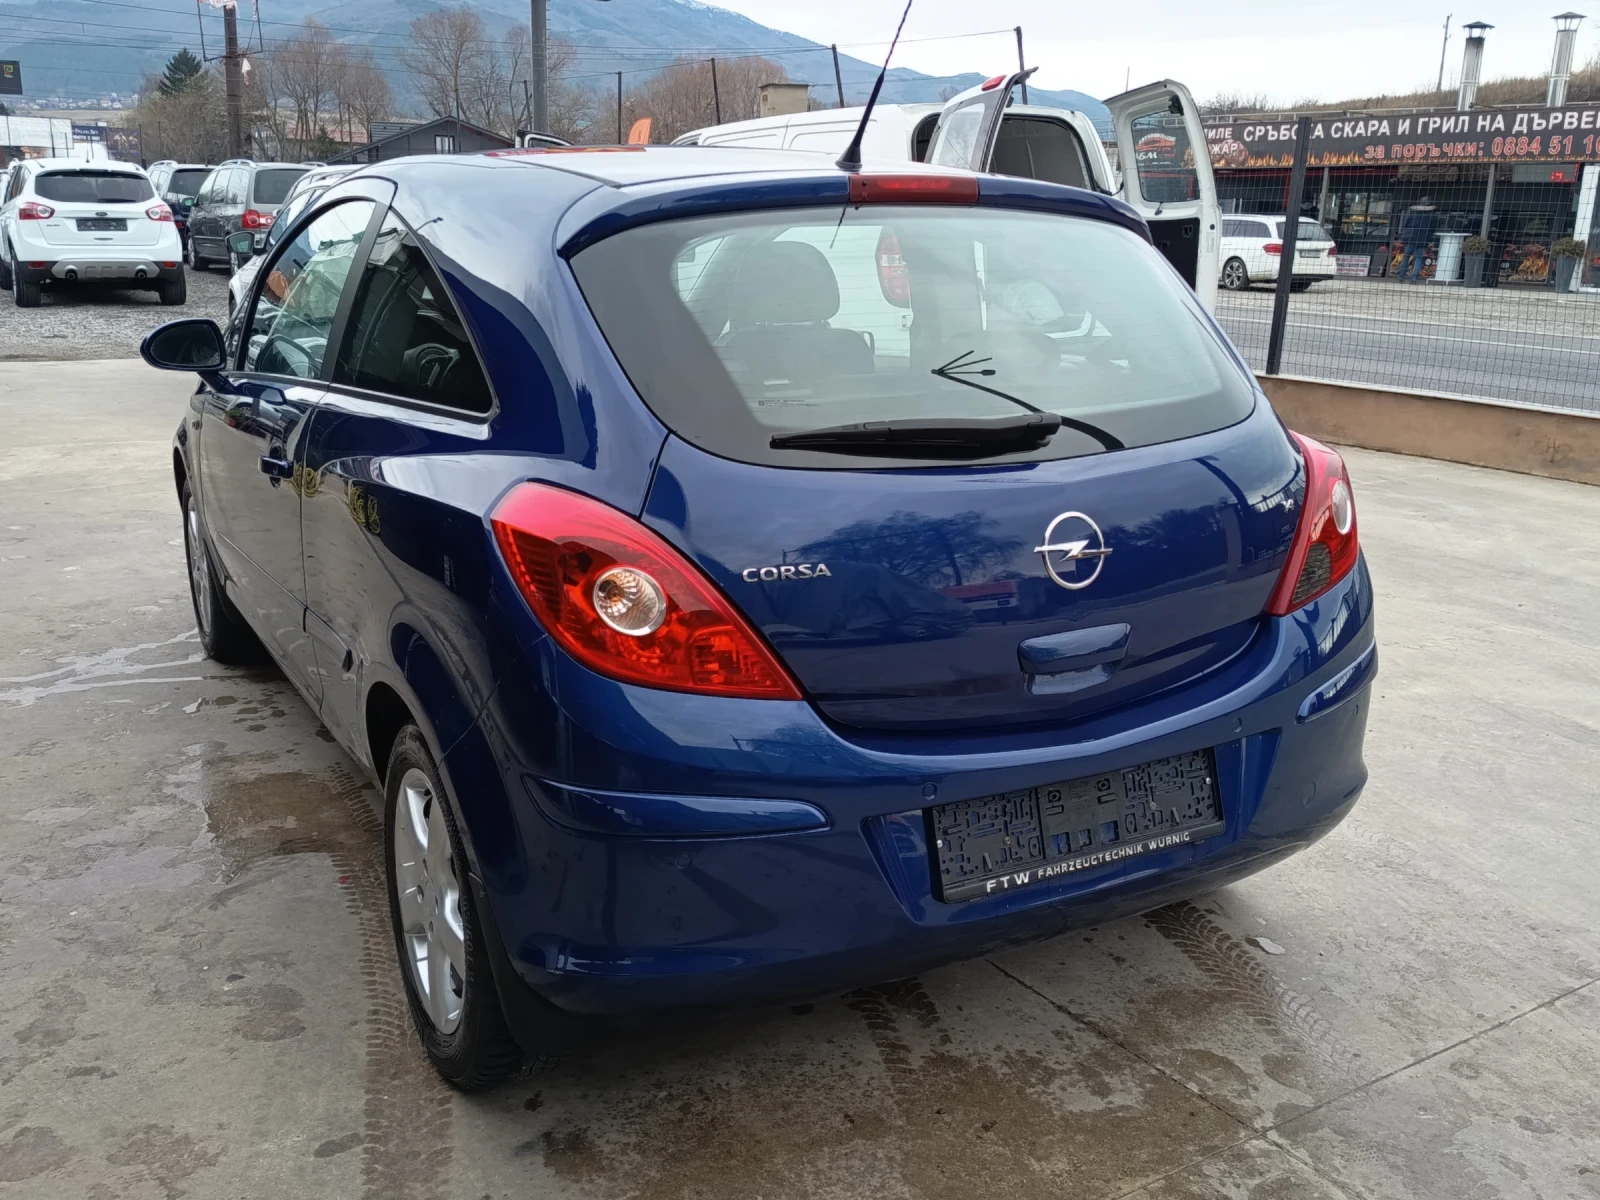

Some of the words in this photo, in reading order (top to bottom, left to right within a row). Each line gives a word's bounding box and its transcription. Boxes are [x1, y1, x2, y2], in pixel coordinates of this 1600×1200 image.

[1243, 122, 1325, 142] СРЪБСА
[1330, 119, 1391, 138] СКАРА
[1397, 118, 1412, 136] И
[1417, 115, 1470, 135] ГРИЛ
[1476, 113, 1506, 133] НА
[1511, 110, 1600, 135] ДЪРВЕ
[1364, 145, 1386, 159] за
[1390, 141, 1485, 161] поръчки:
[1491, 135, 1542, 156] 0884
[1548, 134, 1574, 155] 51
[741, 563, 832, 583] CORSA
[985, 871, 1031, 894] FTW
[1037, 844, 1144, 880] FAHRZEUGTECHNIK
